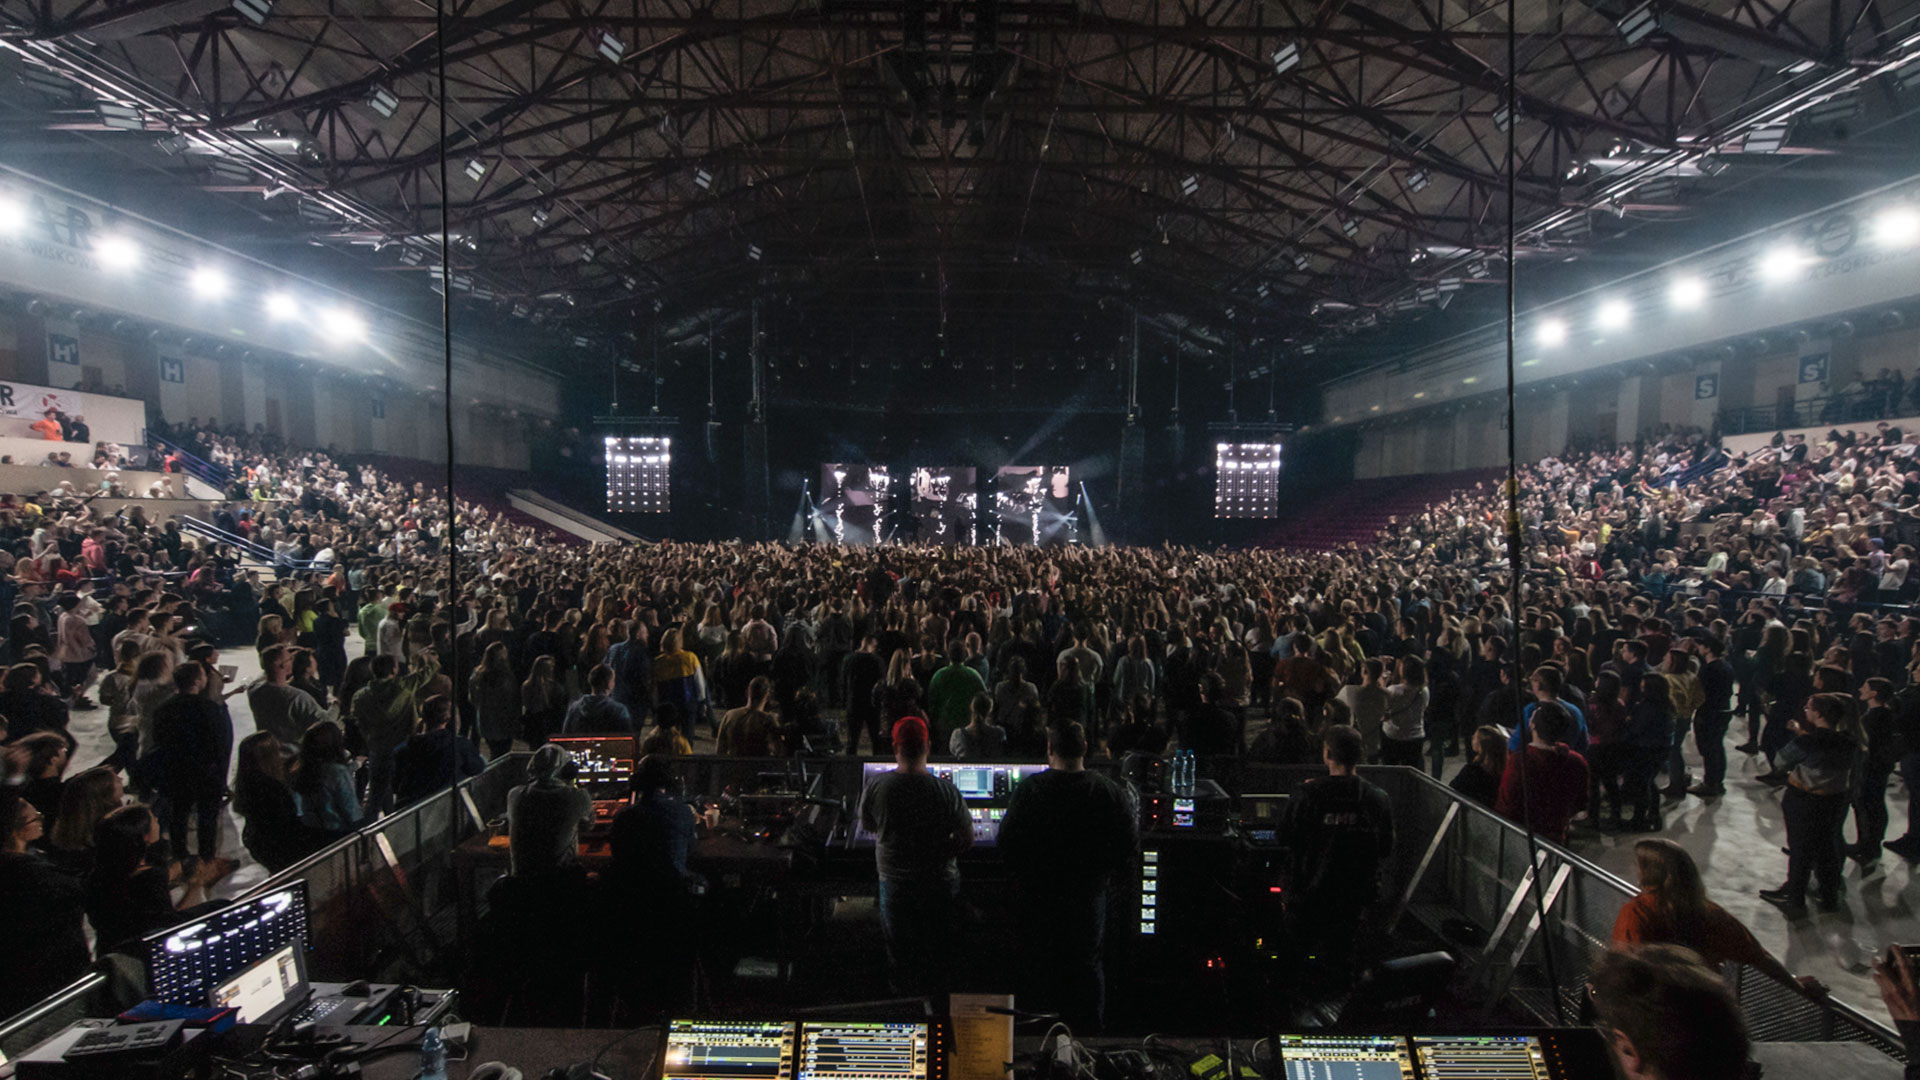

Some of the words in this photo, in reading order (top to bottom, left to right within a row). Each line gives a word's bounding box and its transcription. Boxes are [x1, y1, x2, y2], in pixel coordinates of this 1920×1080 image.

[164, 360, 181, 381] H
[0, 383, 15, 406] R
[1698, 379, 1714, 398] S
